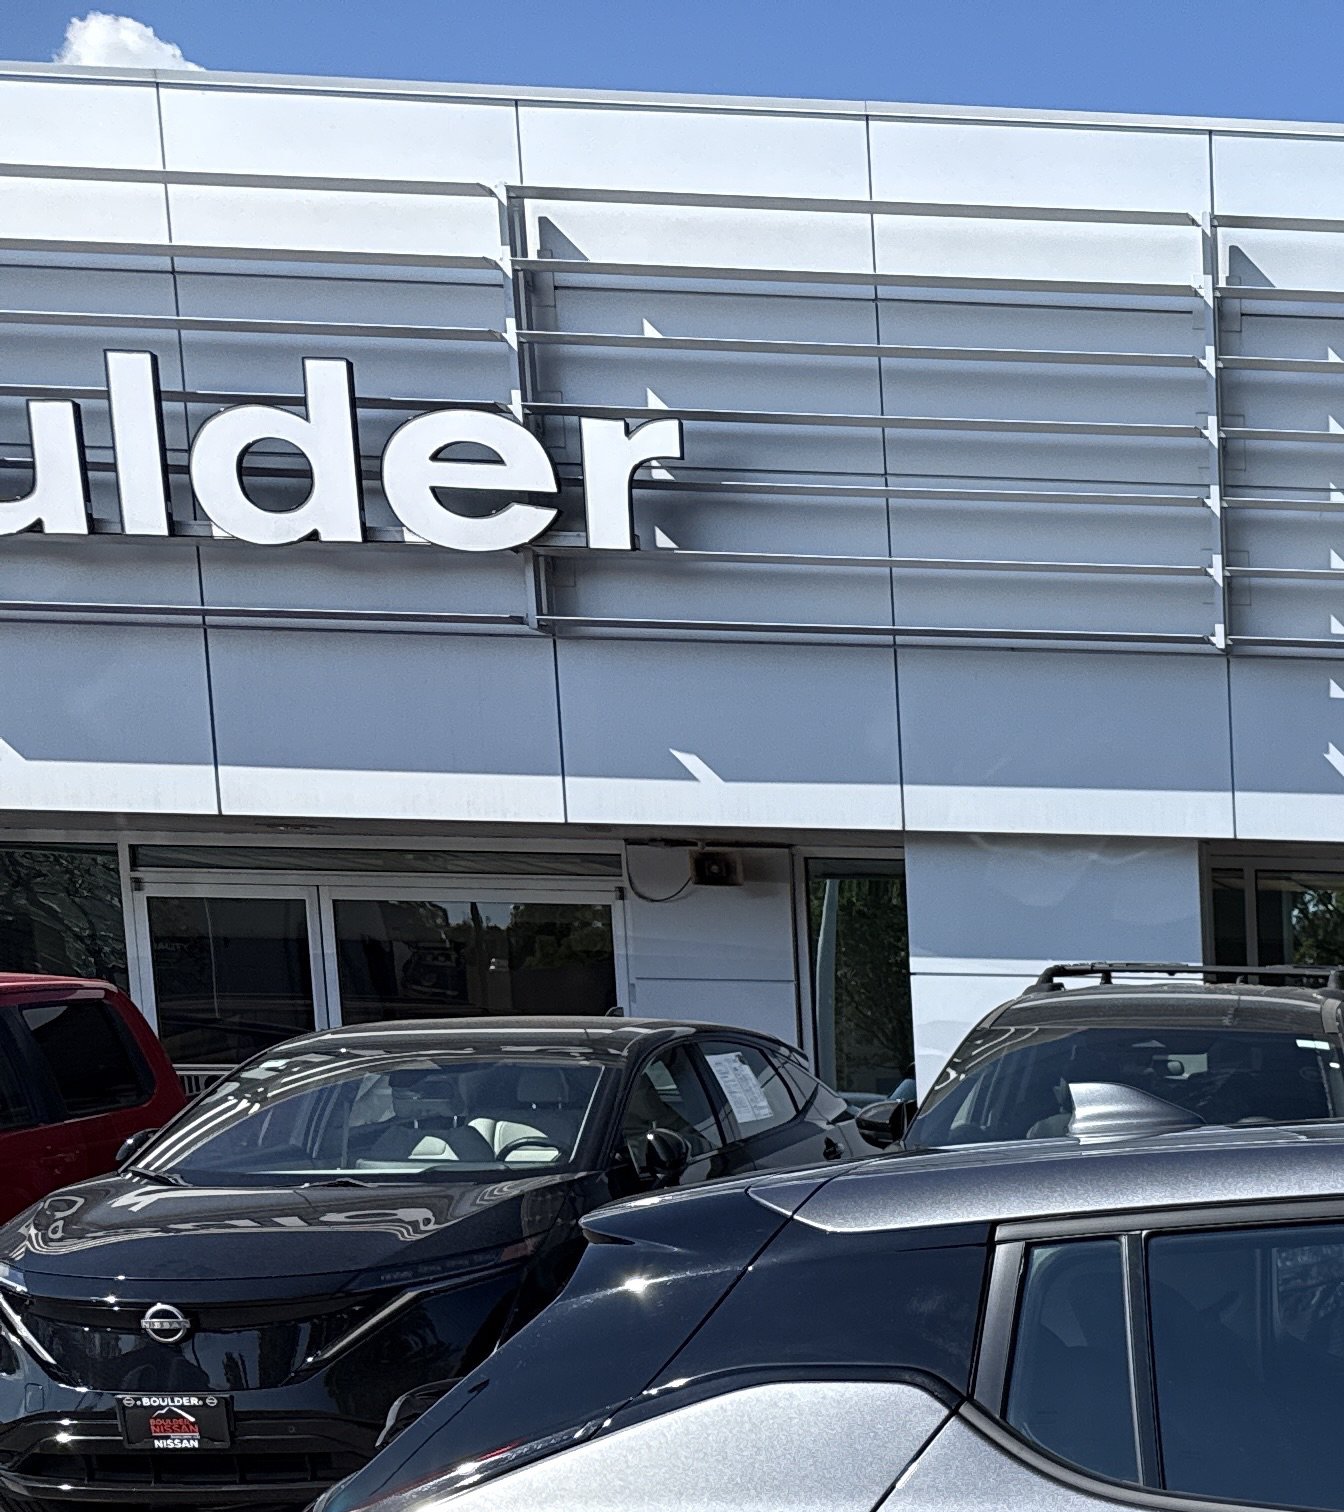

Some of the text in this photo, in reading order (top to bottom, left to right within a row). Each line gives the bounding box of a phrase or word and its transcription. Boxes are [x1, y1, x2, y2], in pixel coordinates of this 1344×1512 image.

[142, 1319, 190, 1328] NISSAN
[142, 1397, 200, 1406] BOULDER
[150, 1418, 190, 1426] BOULDER
[151, 1425, 199, 1434] NISSAN
[154, 1439, 199, 1449] NISSAN
